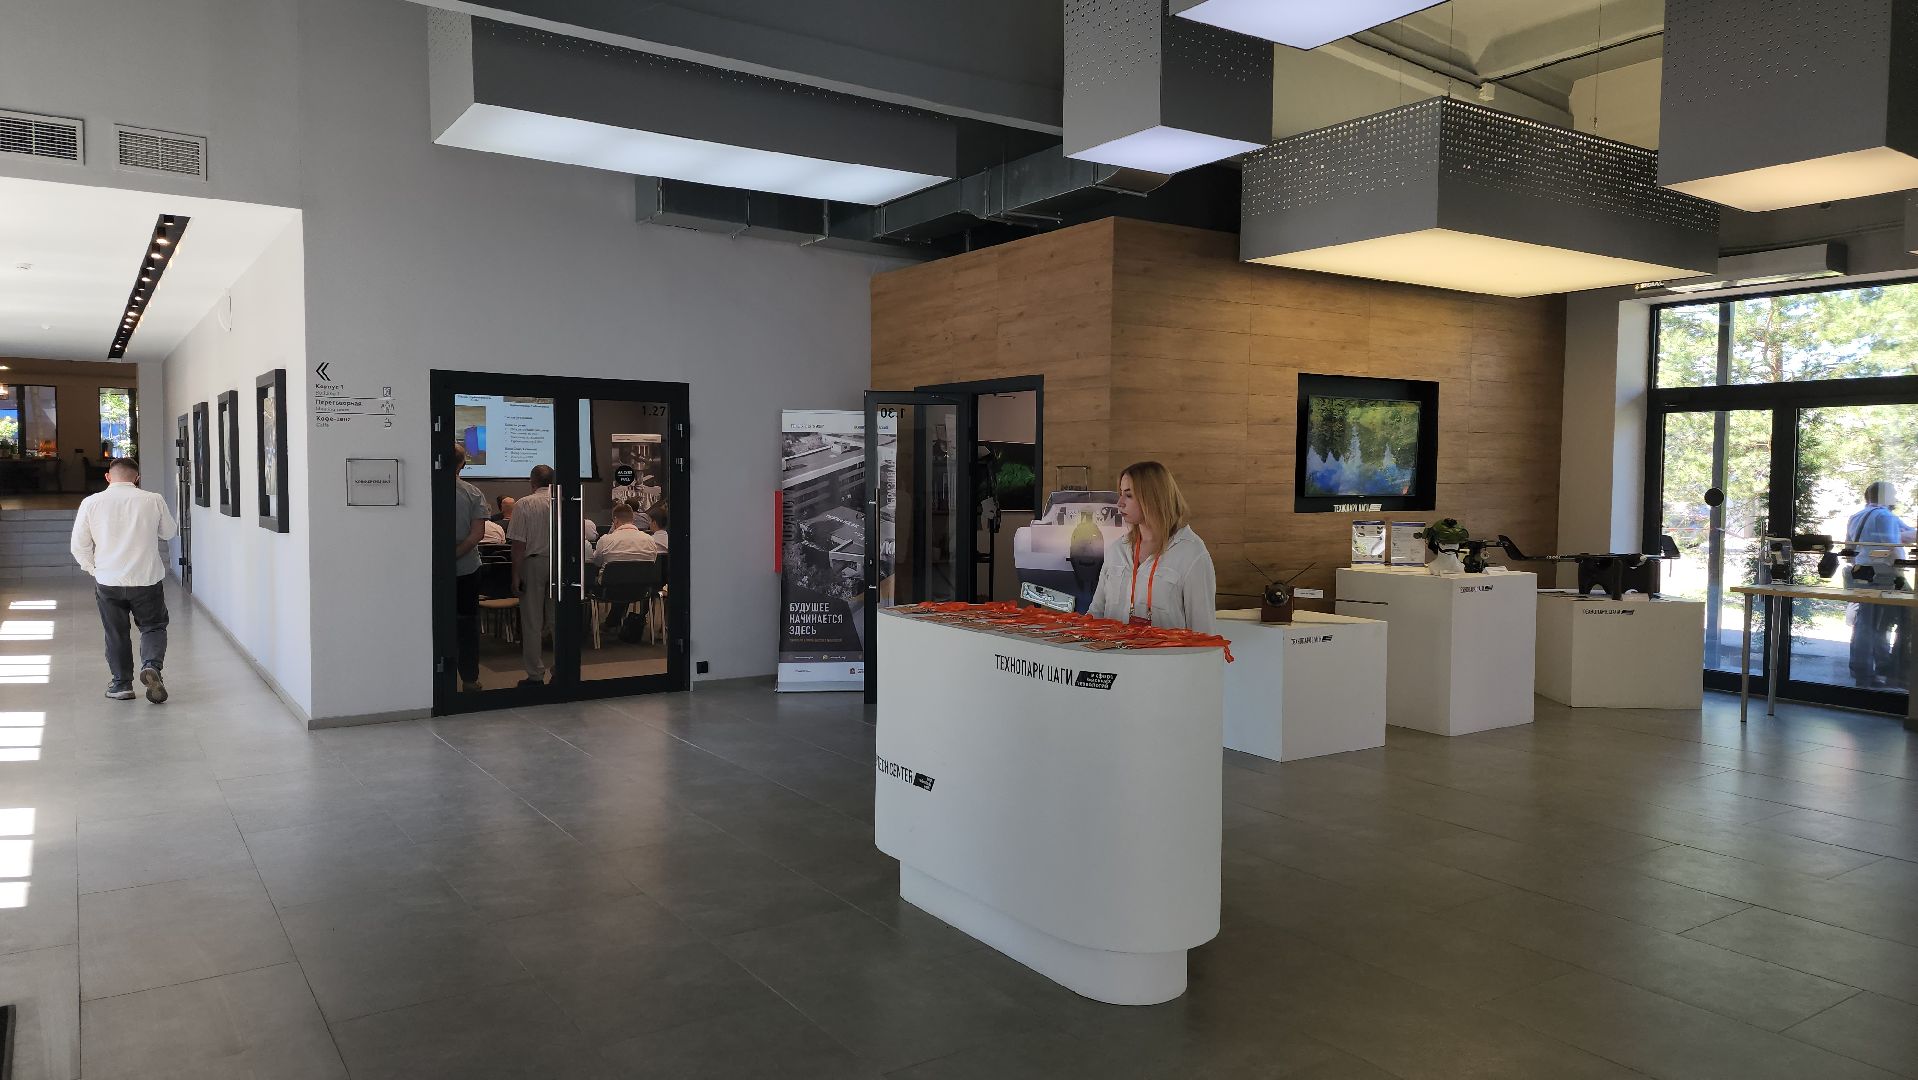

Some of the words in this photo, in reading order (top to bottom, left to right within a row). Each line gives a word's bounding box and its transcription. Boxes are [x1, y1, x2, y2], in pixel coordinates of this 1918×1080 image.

[642, 405, 667, 417] 1.27
[789, 614, 843, 624] НАЧИНАЕТСЯ
[789, 625, 817, 636] ЗДЕСЬ
[994, 653, 1044, 681] ТЕХНОПАРК
[1047, 664, 1074, 686] ЦАГИ
[889, 762, 913, 783] CENTER
